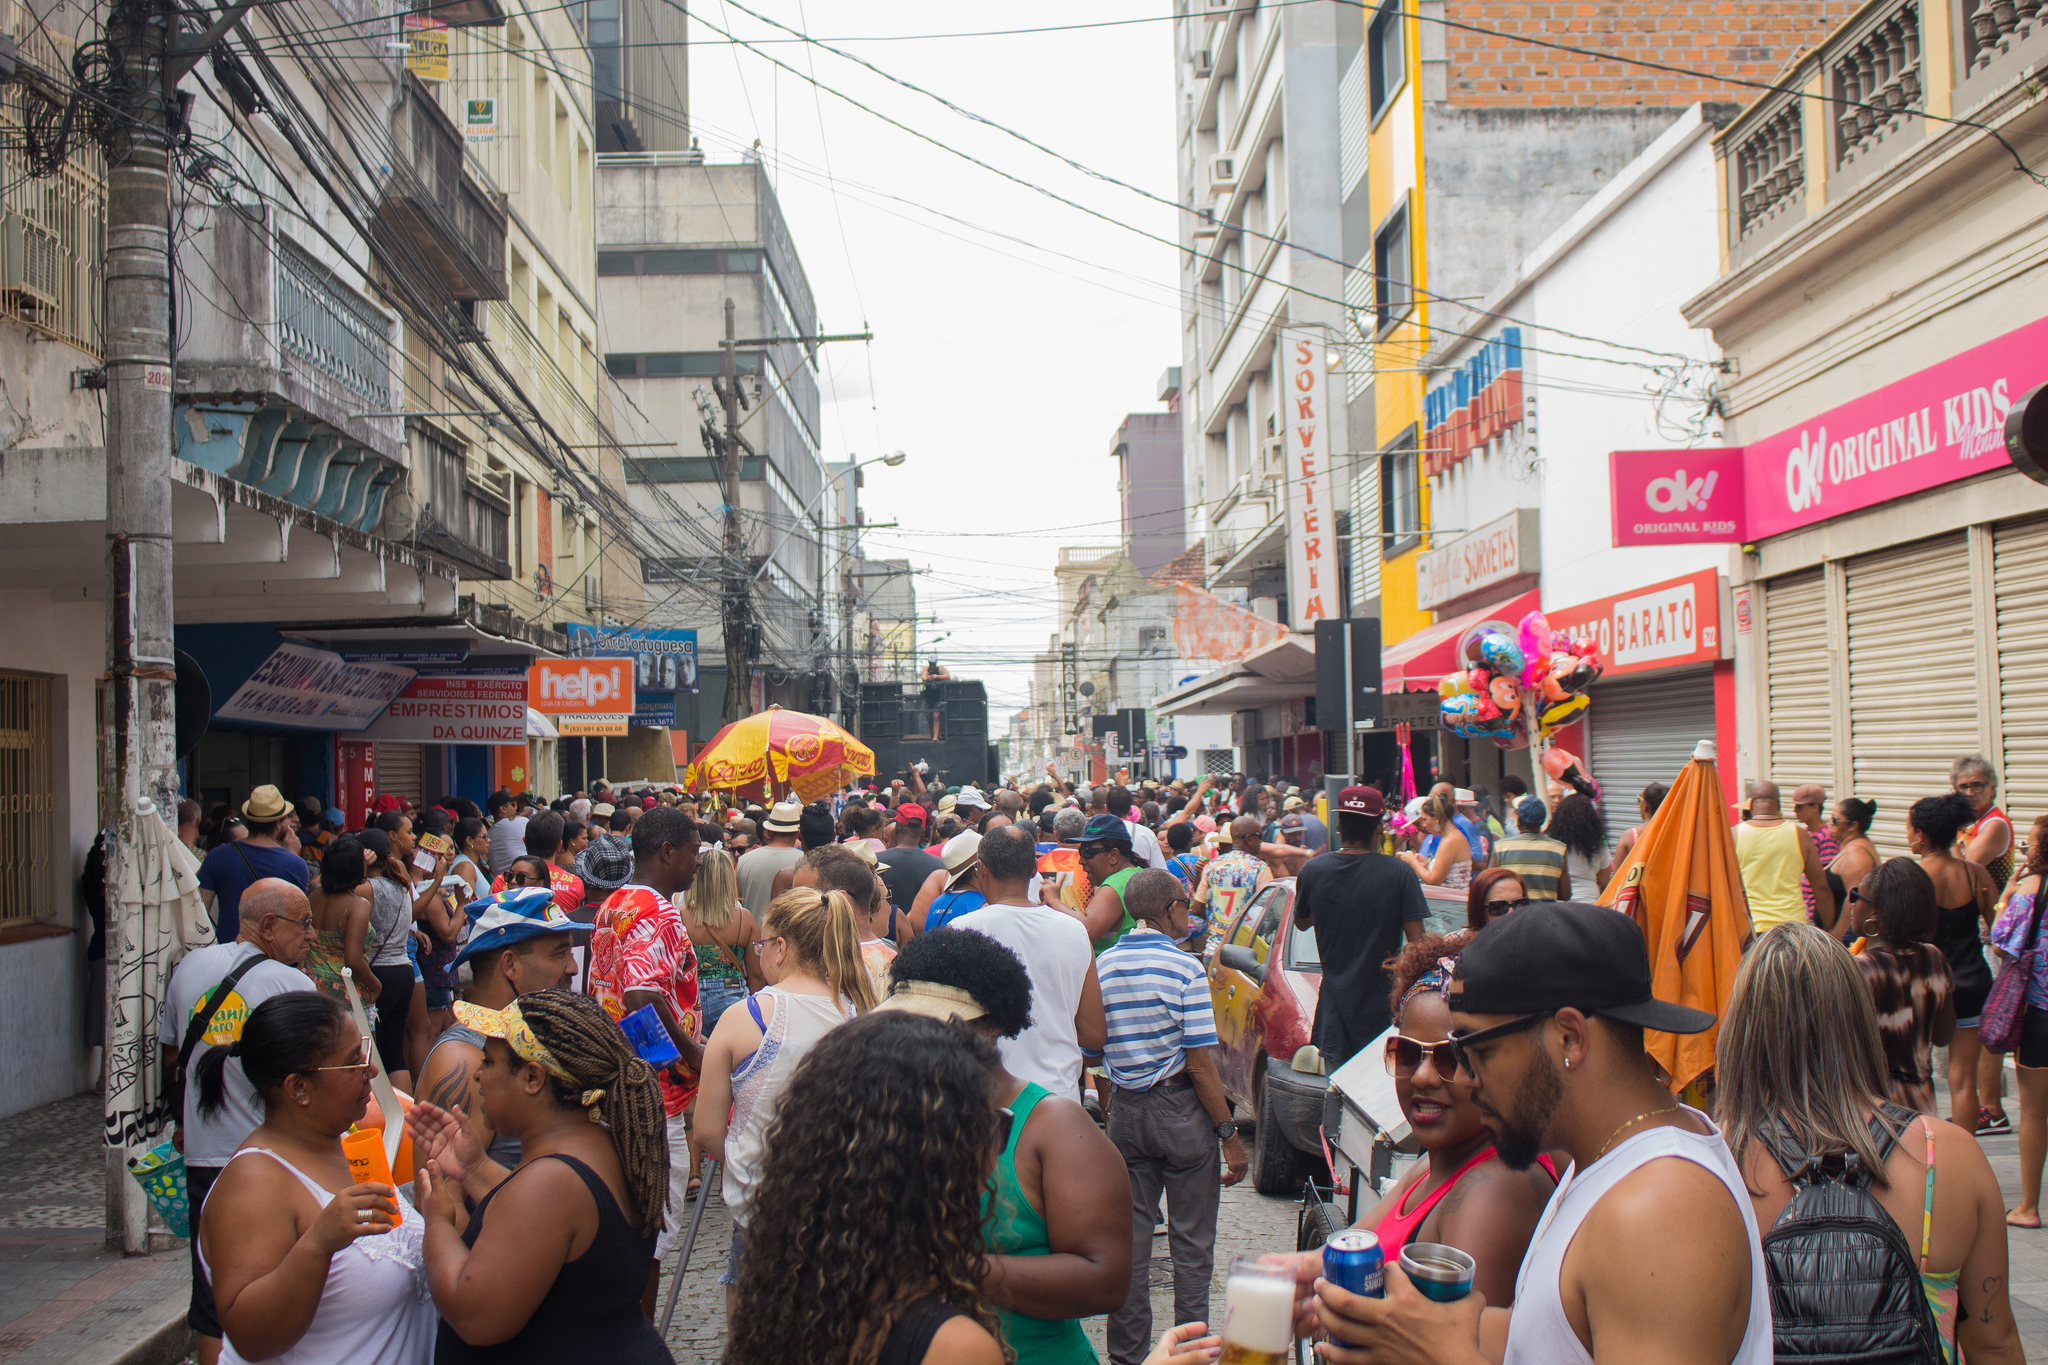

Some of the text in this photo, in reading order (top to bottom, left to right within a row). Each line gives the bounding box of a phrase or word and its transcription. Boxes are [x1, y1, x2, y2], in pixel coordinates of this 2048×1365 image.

[408, 39, 448, 56] ALUGA
[466, 126, 494, 135] ALUGA
[1828, 406, 1938, 486] ORIGINAL
[1942, 377, 2011, 447] KIDS
[1296, 339, 1326, 620] SORVETERIA
[1633, 521, 1700, 534] ORIGINAL
[1703, 520, 1736, 532] KIDS
[1464, 524, 1516, 585] SORVETES
[1617, 598, 1693, 652] BARATO
[250, 650, 324, 690] ESQUINA
[446, 680, 523, 690] INSS EXÉRCITO
[540, 666, 621, 707] help!
[417, 689, 522, 700] SERVIDORES FEDERAIS
[389, 700, 524, 719] EMPRÉSTIMOS
[562, 699, 585, 707] CRÉDITO
[635, 702, 673, 711] ortuguesa
[433, 726, 523, 740] DA QUINZE
[560, 873, 574, 884] DA
[1220, 890, 1236, 917] 7
[208, 1020, 236, 1034] uro
